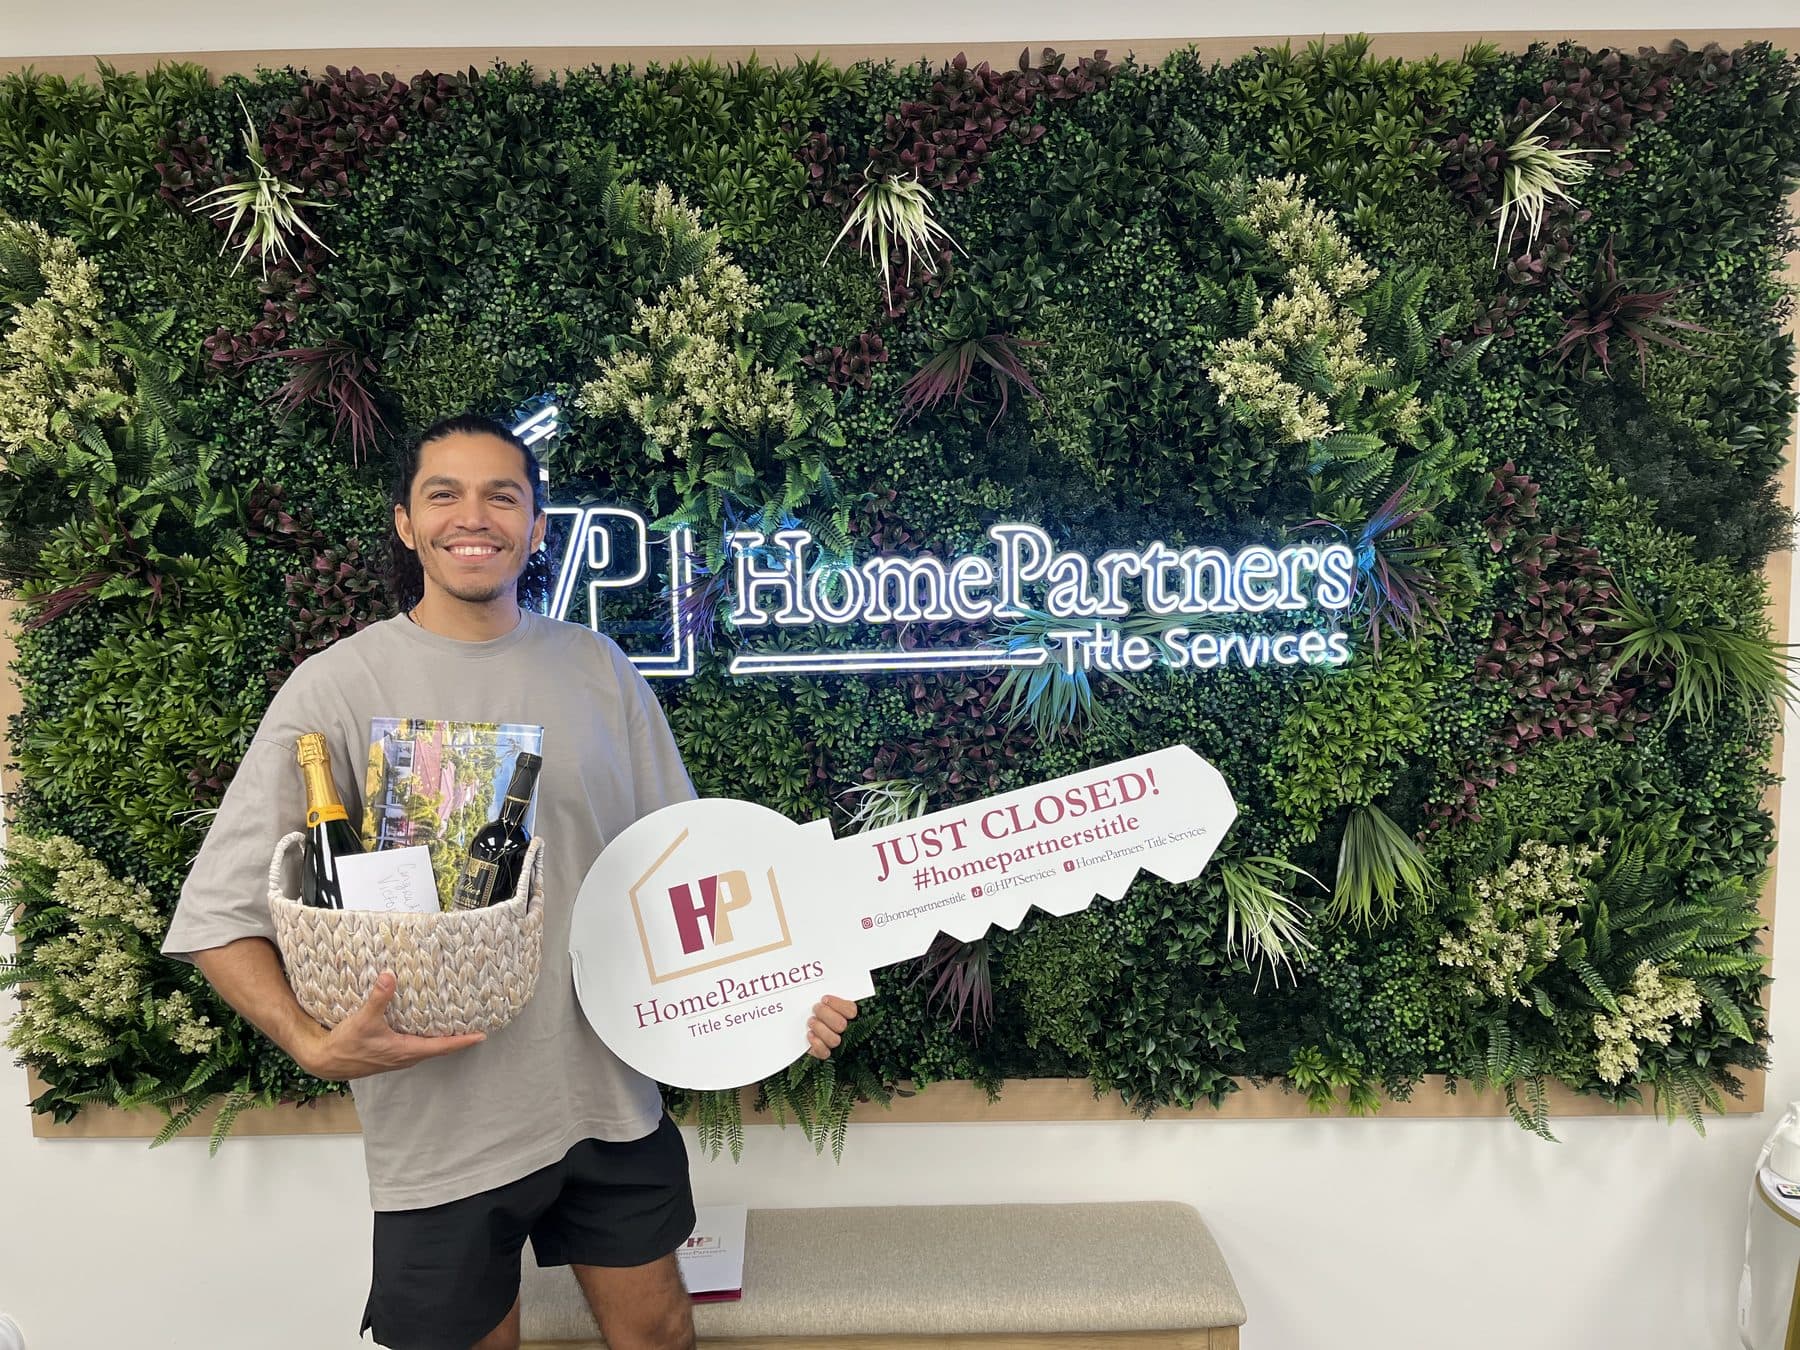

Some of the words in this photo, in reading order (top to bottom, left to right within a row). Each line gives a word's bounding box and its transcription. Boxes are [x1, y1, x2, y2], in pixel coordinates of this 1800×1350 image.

[729, 524, 1354, 626] HomePartners
[1047, 622, 1151, 675] Title
[1162, 628, 1349, 668] Services
[872, 818, 968, 882] JUST
[980, 767, 1160, 840] CLOSED!
[912, 813, 1140, 891] #homepartnerstitle
[668, 870, 752, 955] HP
[874, 891, 966, 927] @homepartnerstitle
[984, 867, 1057, 896] @HPTServices
[1076, 843, 1145, 869] HomePartners
[1144, 836, 1168, 850] Title
[1168, 826, 1207, 842] Services
[633, 960, 824, 1029] HomePartners
[688, 1018, 722, 1038] Title
[725, 1001, 784, 1028] Services
